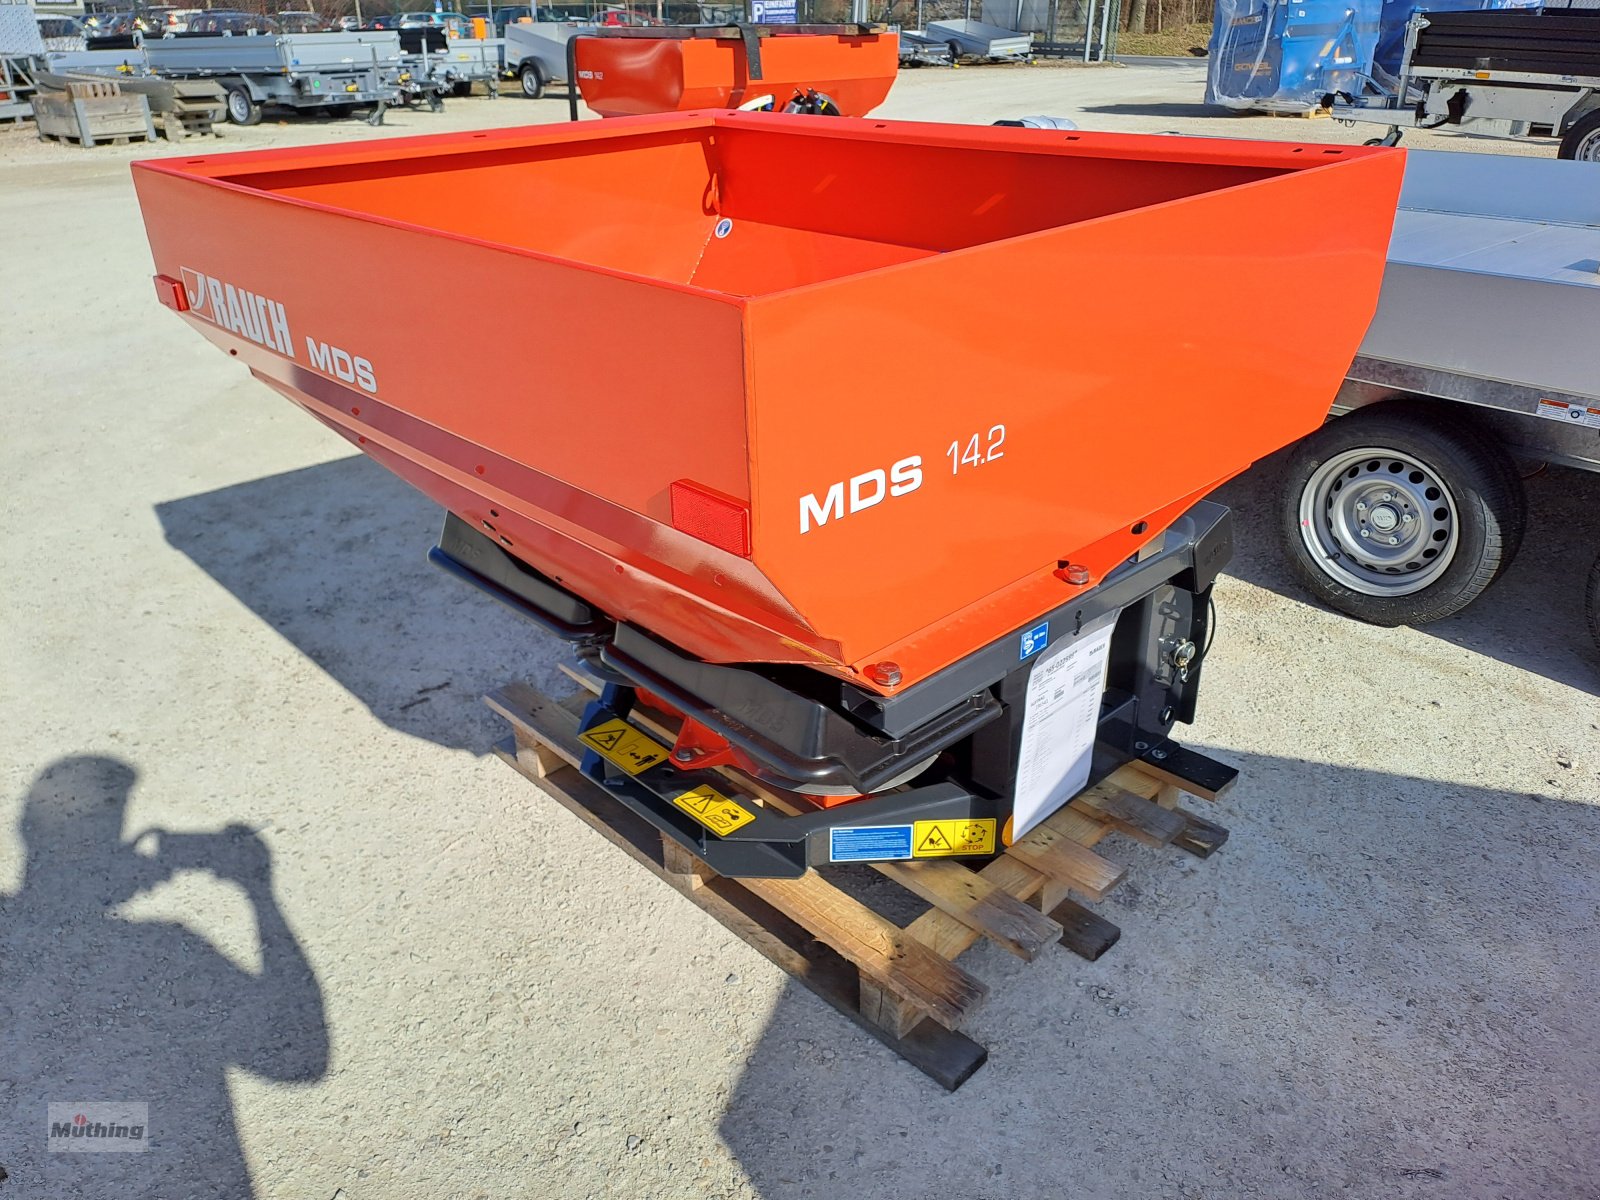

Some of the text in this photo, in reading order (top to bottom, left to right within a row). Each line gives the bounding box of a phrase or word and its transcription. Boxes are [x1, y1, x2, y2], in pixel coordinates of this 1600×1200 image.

[206, 275, 377, 393] RAUCH MDS
[799, 424, 1005, 535] MDS 14.2
